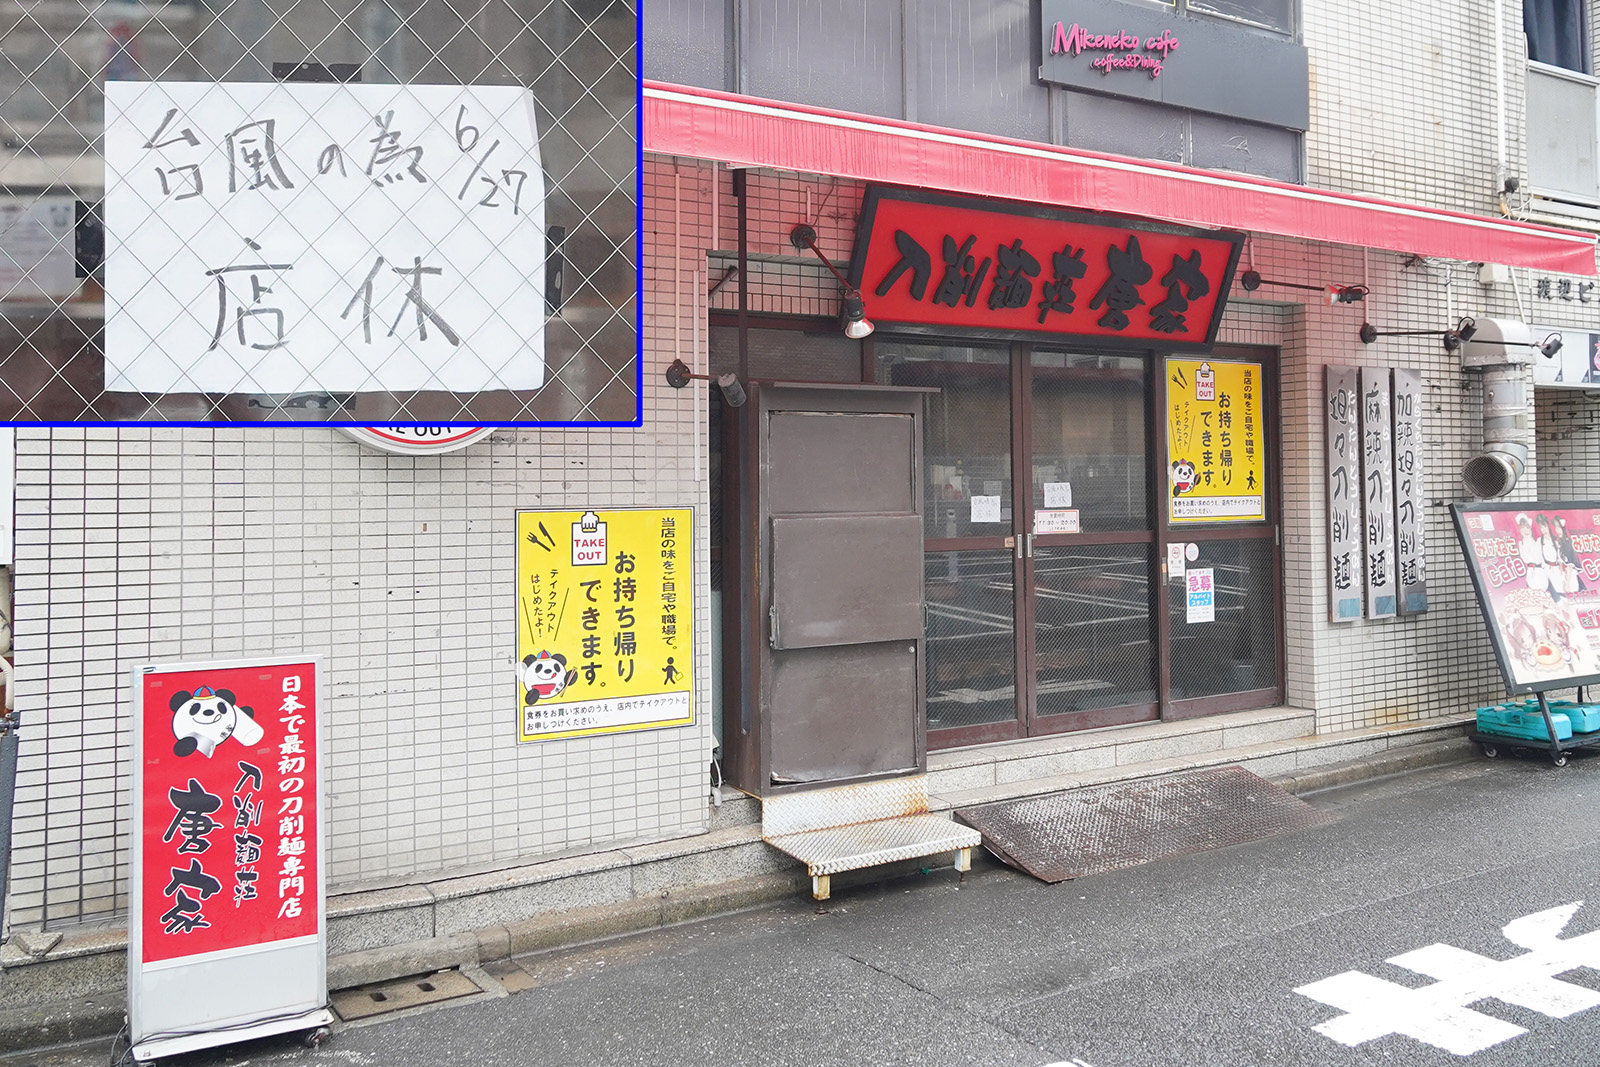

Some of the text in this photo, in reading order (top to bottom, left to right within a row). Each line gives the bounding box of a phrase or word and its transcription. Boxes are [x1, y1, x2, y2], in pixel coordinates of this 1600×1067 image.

[1051, 21, 1180, 60] Mikeneko cafe
[1091, 53, 1164, 77] coffee&Dining
[142, 103, 528, 216] 台風の為 6/27
[204, 236, 461, 351] 店休
[1537, 277, 1600, 303] 渡辺ビ
[1196, 381, 1214, 389] TAKE
[1198, 390, 1213, 398] OUT
[1200, 410, 1218, 489] できます。
[1218, 391, 1233, 487] お持ち帰り
[1347, 389, 1360, 588] たんたんとうしょうめん
[573, 537, 606, 548] TAKE
[576, 550, 603, 561] OUT
[660, 516, 678, 651] 当店の味をご自宅や職場で。
[1188, 575, 1212, 592] 急募
[1486, 556, 1527, 588] Cafe
[546, 568, 559, 633] テイクアウト
[612, 550, 637, 684] お持ち帰り
[1191, 599, 1209, 607] スタッフ
[579, 578, 606, 688] できます。
[526, 696, 688, 720] 食券をお買い求めのうえ、店内でテイクアウトと
[526, 716, 600, 732] お申しつけください。
[276, 674, 307, 920] 日本で最初の刀削麺専門店
[159, 777, 224, 935] 唐家
